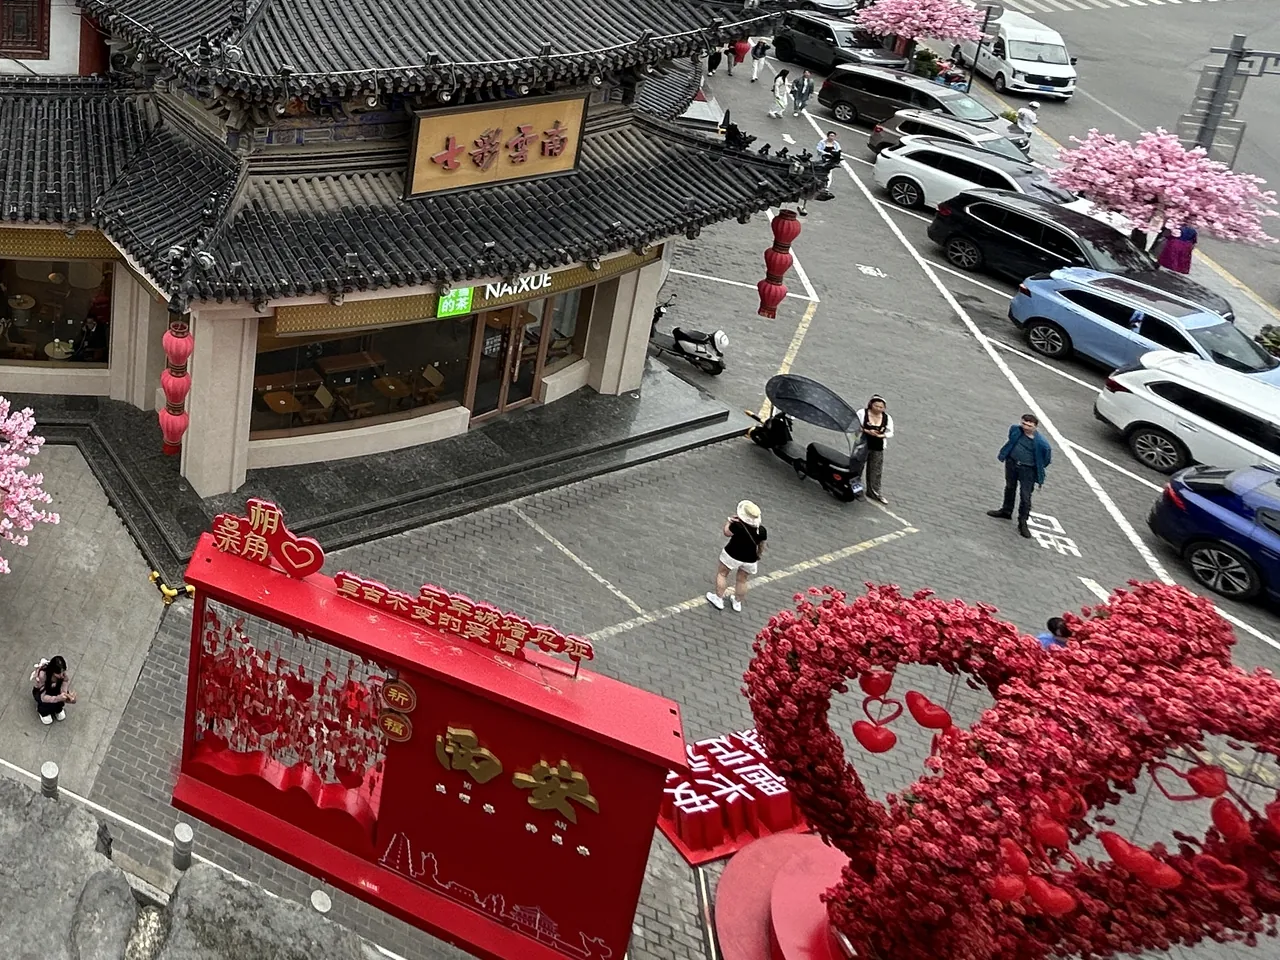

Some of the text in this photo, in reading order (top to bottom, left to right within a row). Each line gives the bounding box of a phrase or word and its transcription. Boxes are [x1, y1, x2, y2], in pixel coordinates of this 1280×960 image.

[431, 120, 568, 172] 七彩雲南
[441, 297, 468, 313] 的茶
[420, 588, 591, 660] 千年城墙见证
[384, 688, 409, 736] 祈福
[436, 726, 600, 825] 西安
